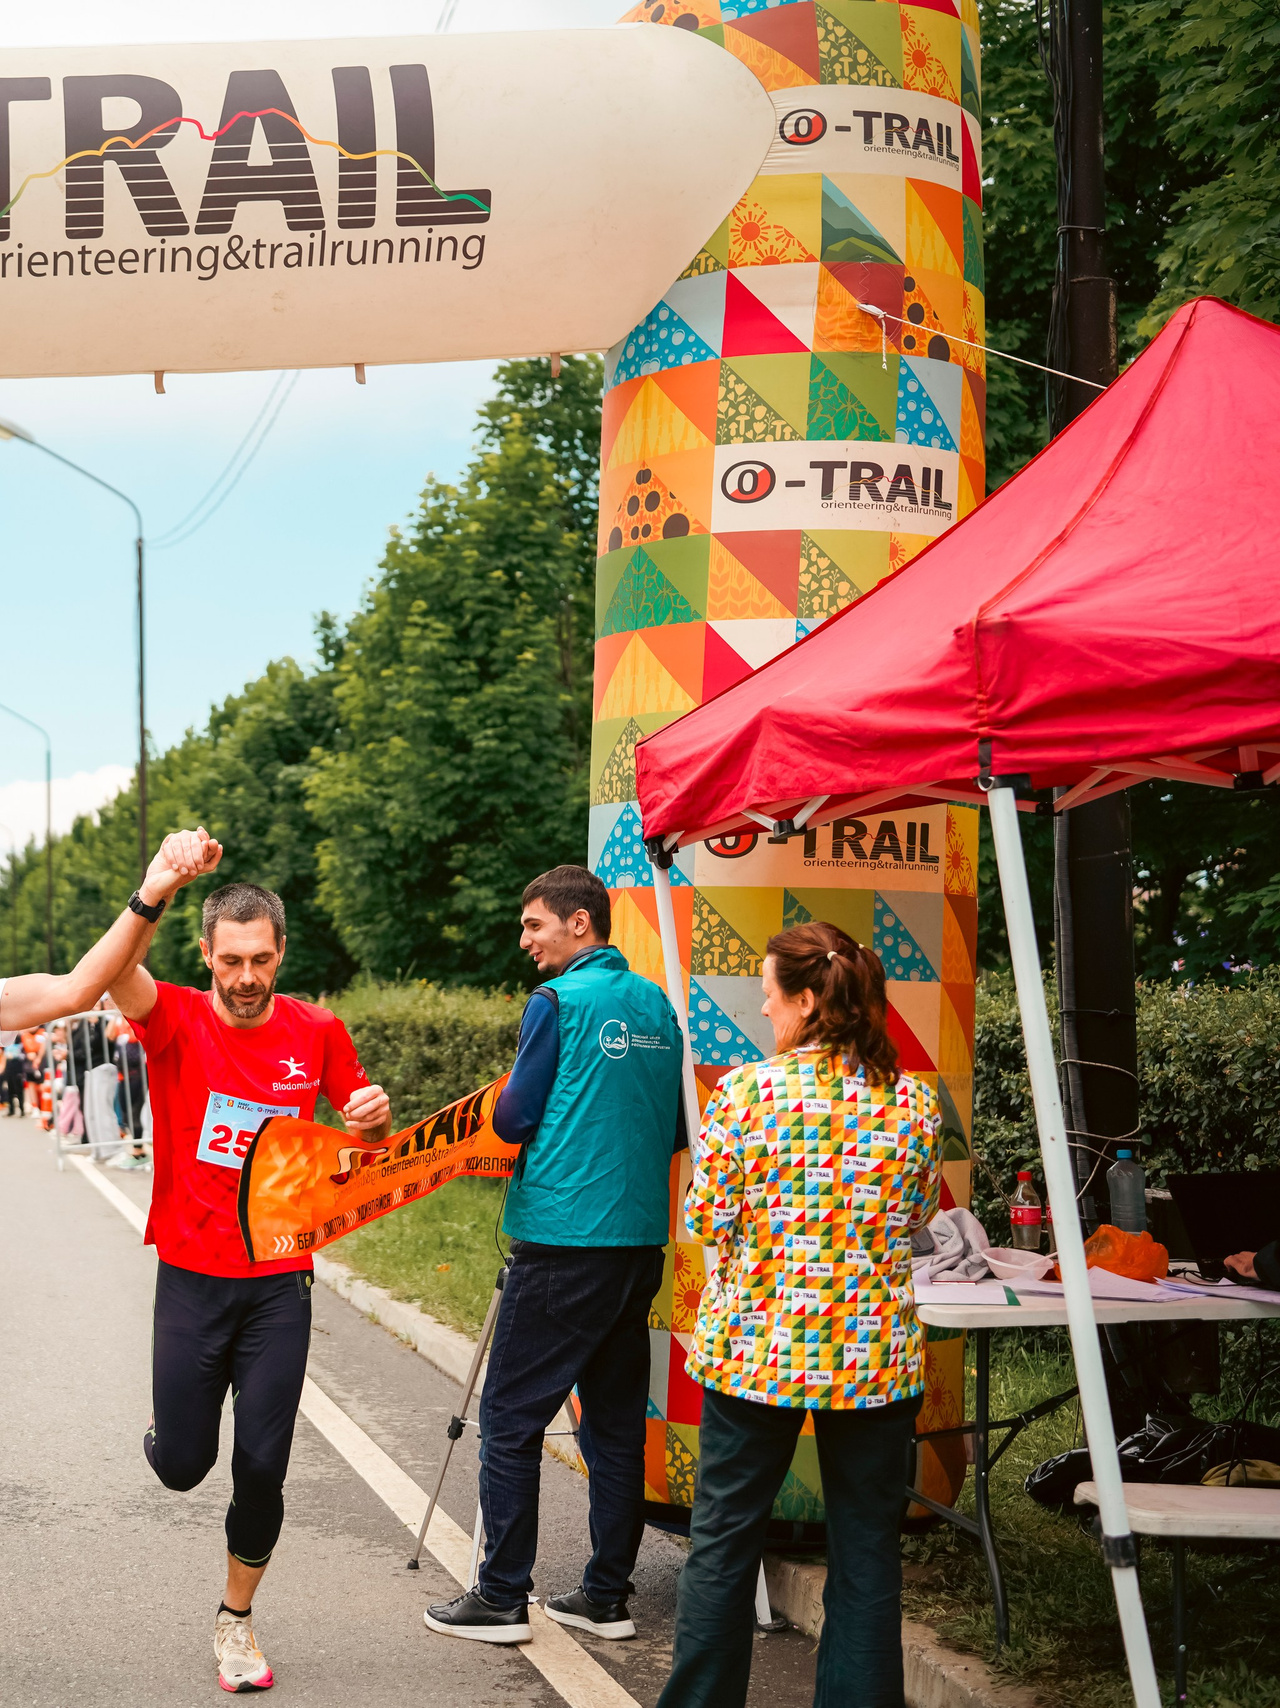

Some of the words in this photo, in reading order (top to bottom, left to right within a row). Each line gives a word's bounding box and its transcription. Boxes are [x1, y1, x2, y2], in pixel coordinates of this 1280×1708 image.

[864, 144, 960, 171] orienteering&trailrunning
[821, 499, 953, 521] orienteering&trailrunning
[803, 859, 939, 874] orienteering&trailrunning
[208, 1124, 257, 1159] 25
